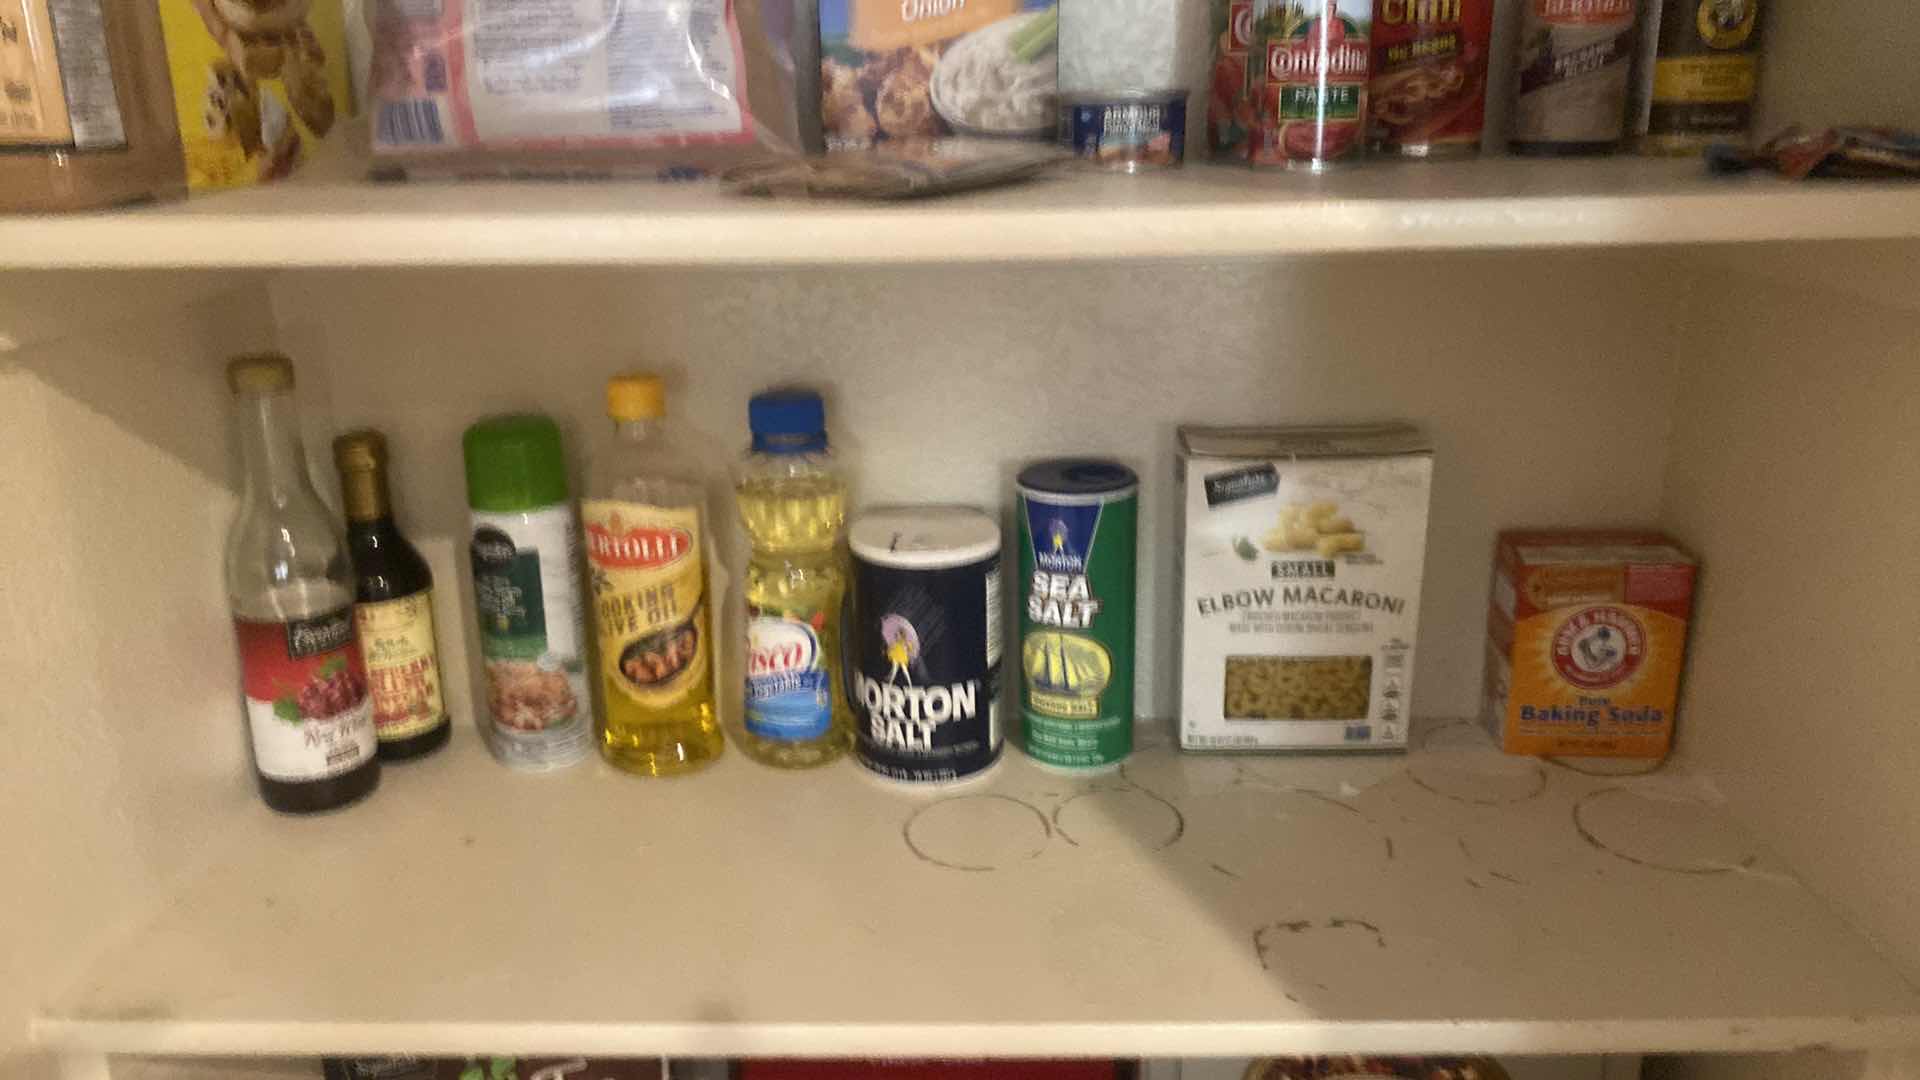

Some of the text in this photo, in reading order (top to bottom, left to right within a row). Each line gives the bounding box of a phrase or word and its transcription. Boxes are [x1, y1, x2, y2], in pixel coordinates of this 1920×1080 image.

[1295, 86, 1350, 104] PATE
[1031, 570, 1090, 601] SEA
[1197, 585, 1406, 617] ELBOW MACARONI
[1027, 594, 1099, 628] SALT
[1520, 704, 1664, 727] Baking Soda
[871, 712, 937, 752] SALT
